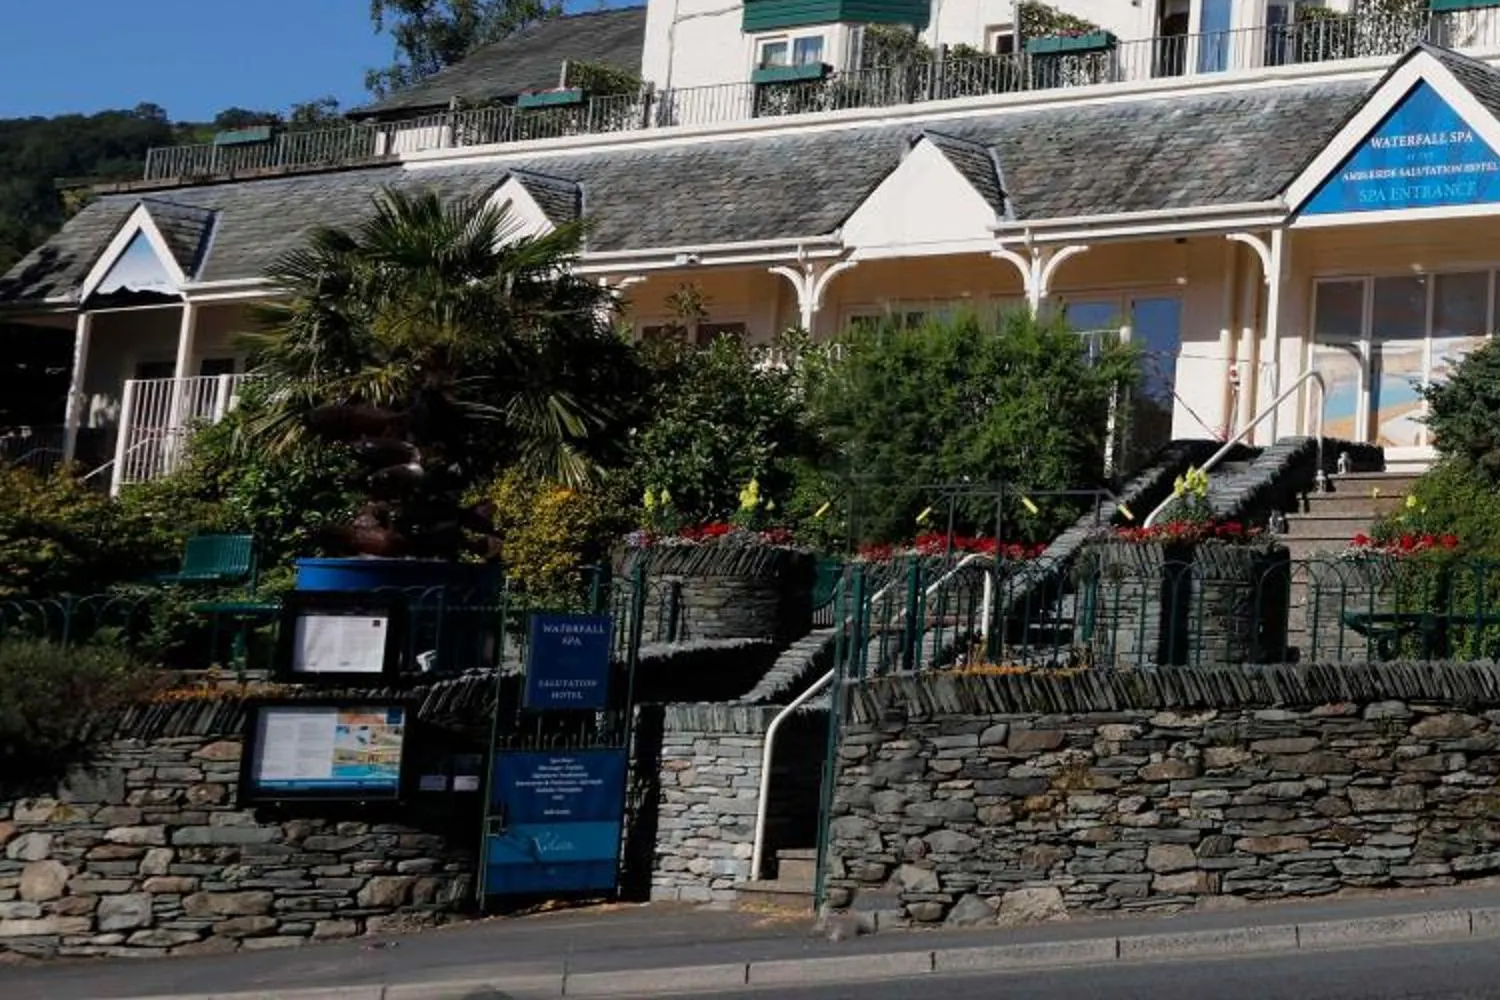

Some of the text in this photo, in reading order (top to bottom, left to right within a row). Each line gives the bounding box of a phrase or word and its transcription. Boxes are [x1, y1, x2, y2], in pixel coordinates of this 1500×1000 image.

[1371, 130, 1473, 149] WATERFALL SPA
[1399, 164, 1461, 178] SALUTATION
[1359, 182, 1476, 202] SPA ENTRANCE
[543, 624, 605, 634] WATERFALL
[562, 635, 582, 647] SPA
[551, 691, 583, 700] HOTEL
